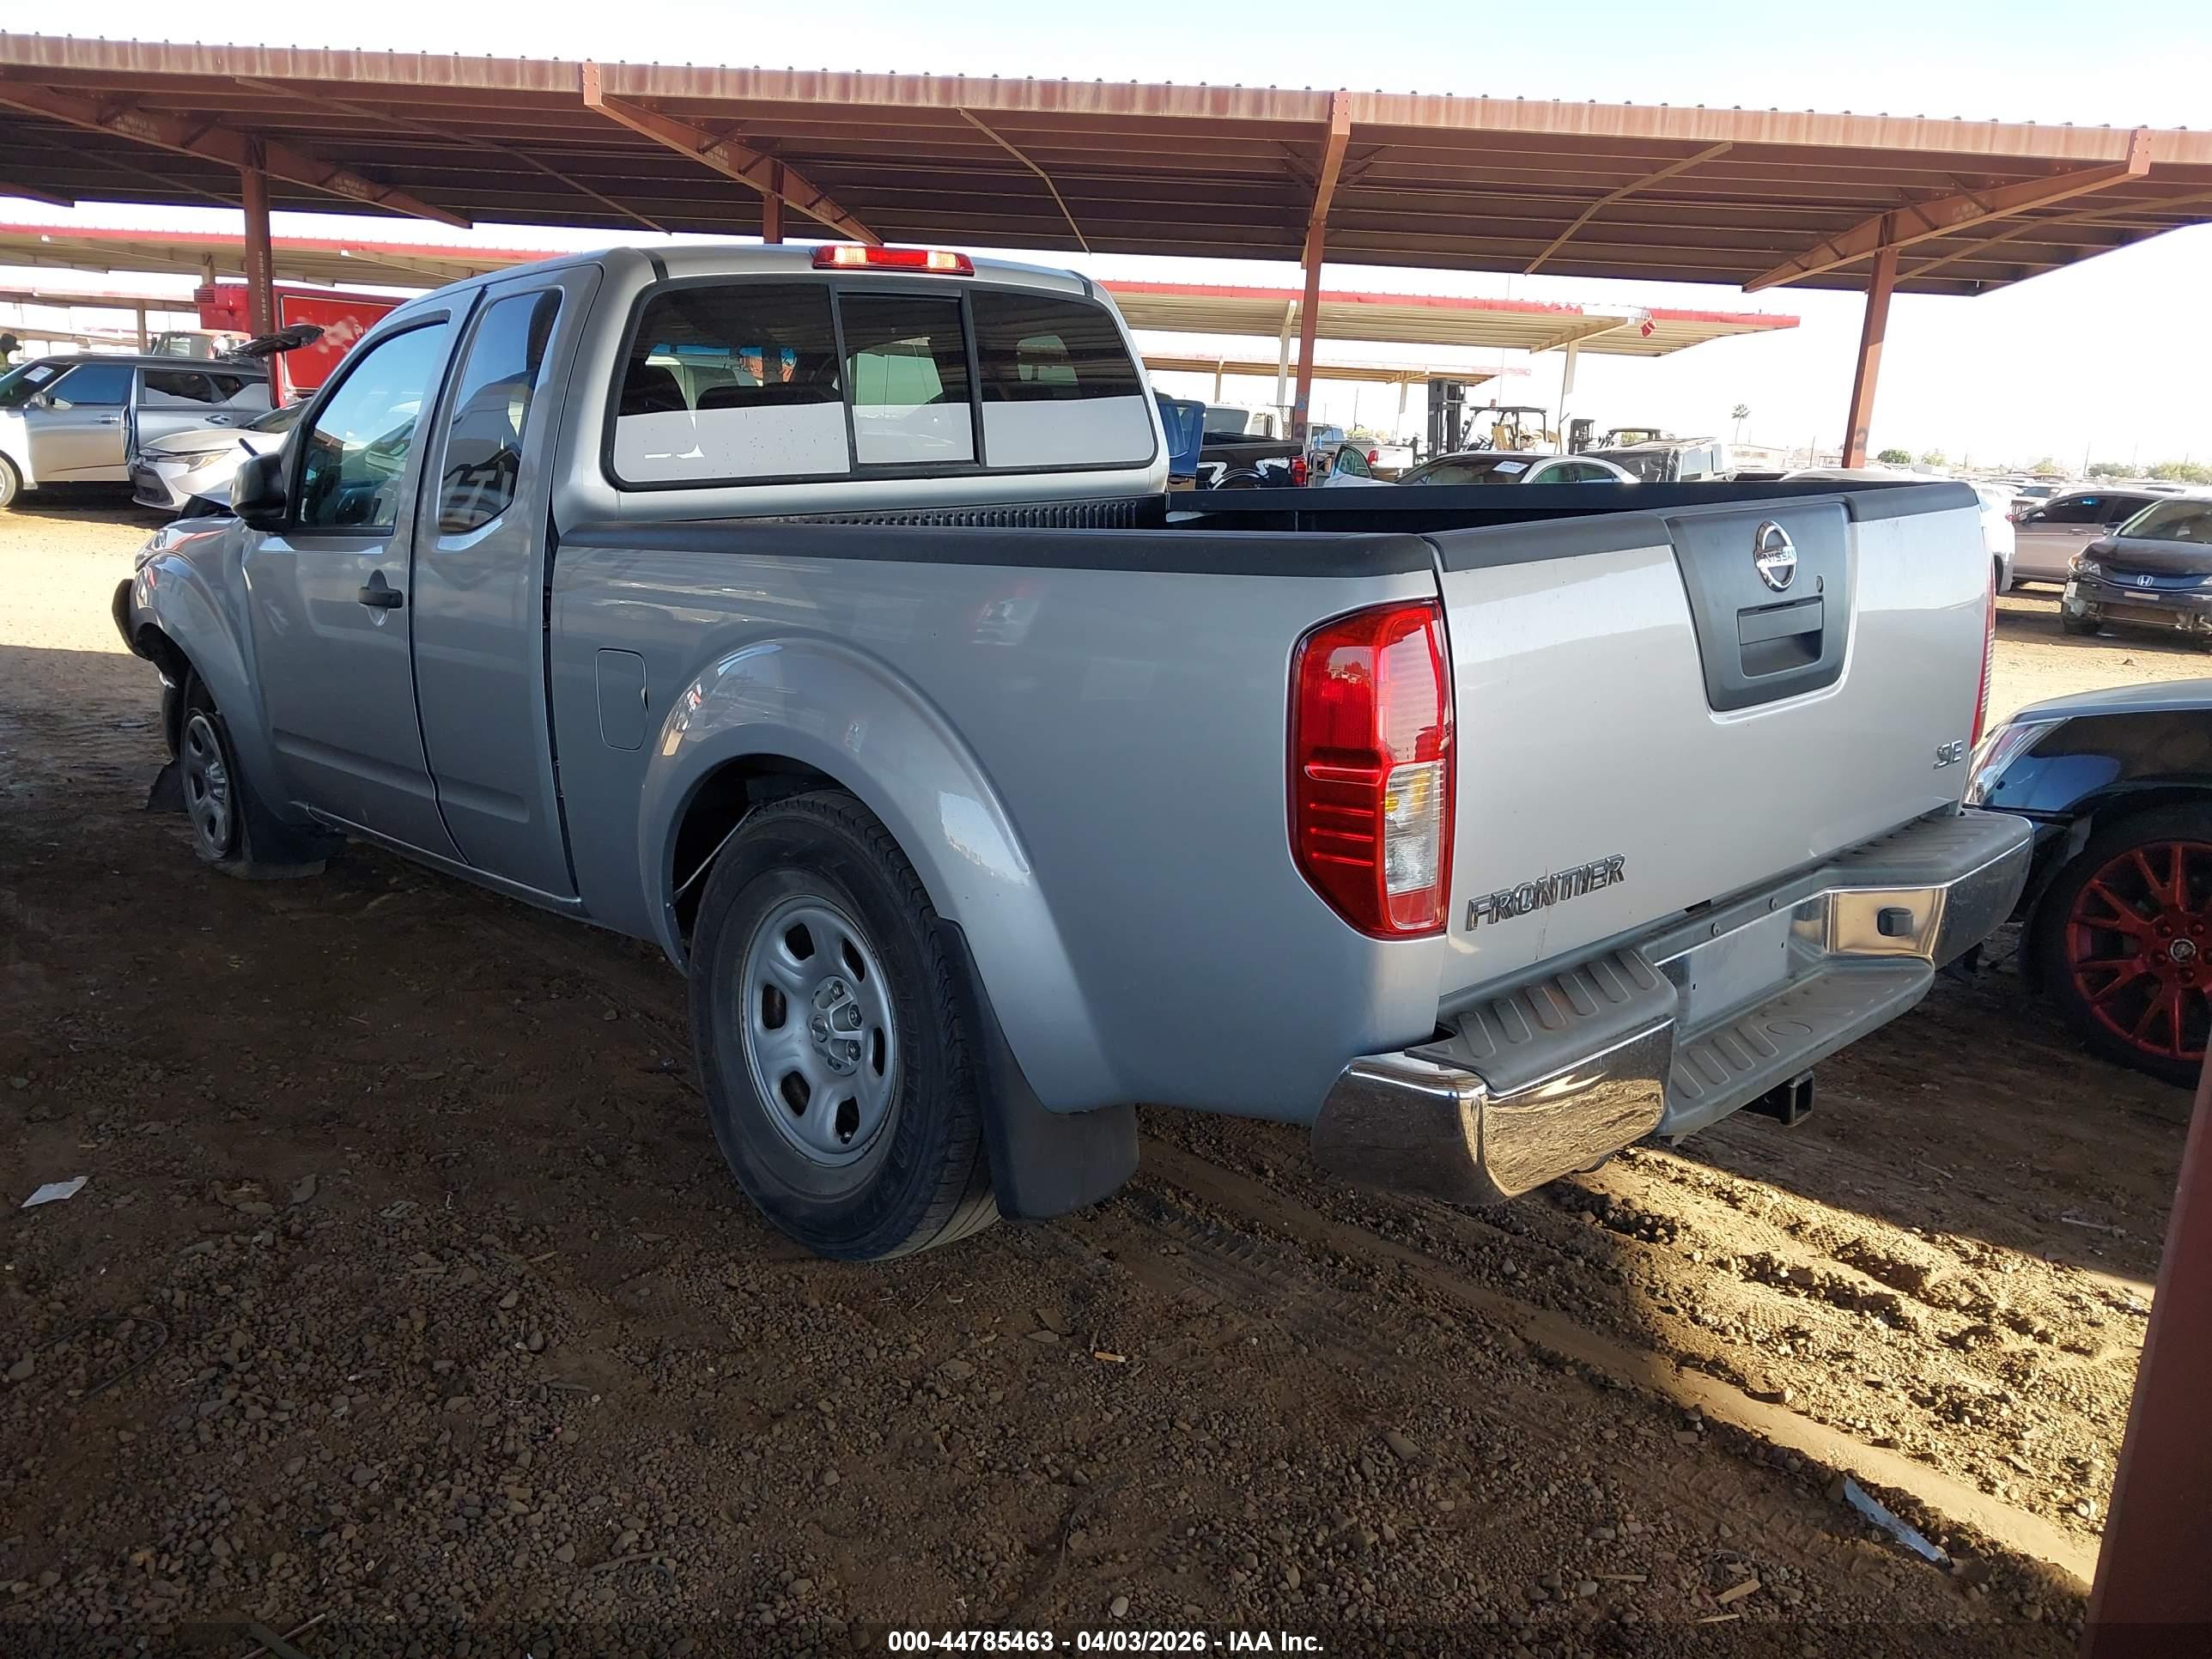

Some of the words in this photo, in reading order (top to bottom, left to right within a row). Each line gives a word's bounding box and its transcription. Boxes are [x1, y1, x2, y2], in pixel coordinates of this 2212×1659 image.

[1763, 548, 1796, 563] NISSAN
[1934, 739, 1963, 770] SE
[1466, 853, 1626, 931] FRONTIER
